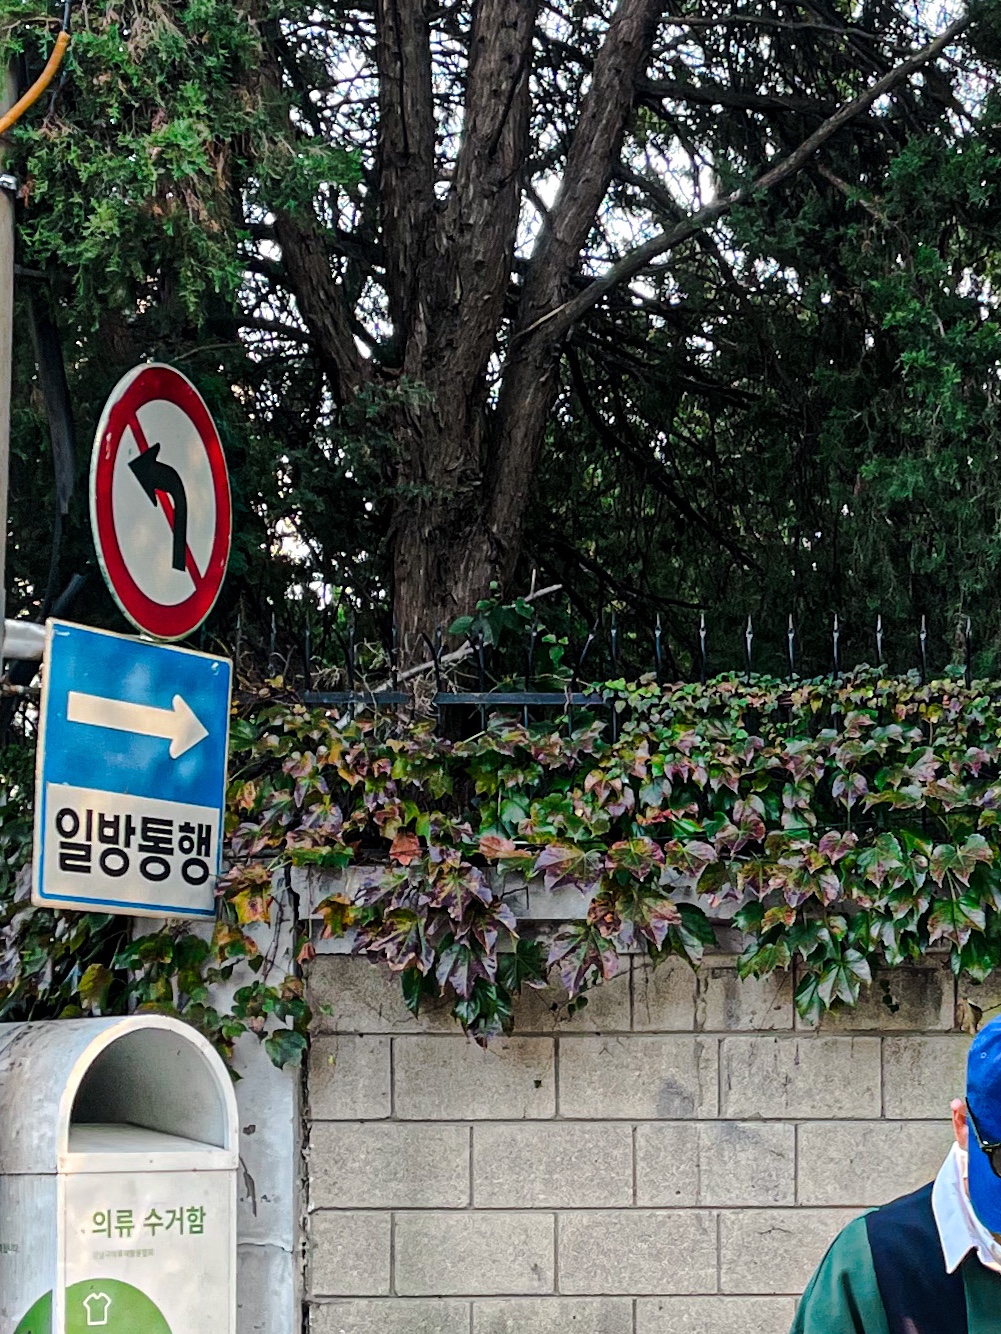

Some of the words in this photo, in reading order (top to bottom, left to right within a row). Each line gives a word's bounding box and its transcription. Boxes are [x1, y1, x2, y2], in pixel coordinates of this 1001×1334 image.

[56, 807, 212, 886] 일방통행
[92, 1209, 135, 1238] 의류
[143, 1206, 206, 1236] 수거함
